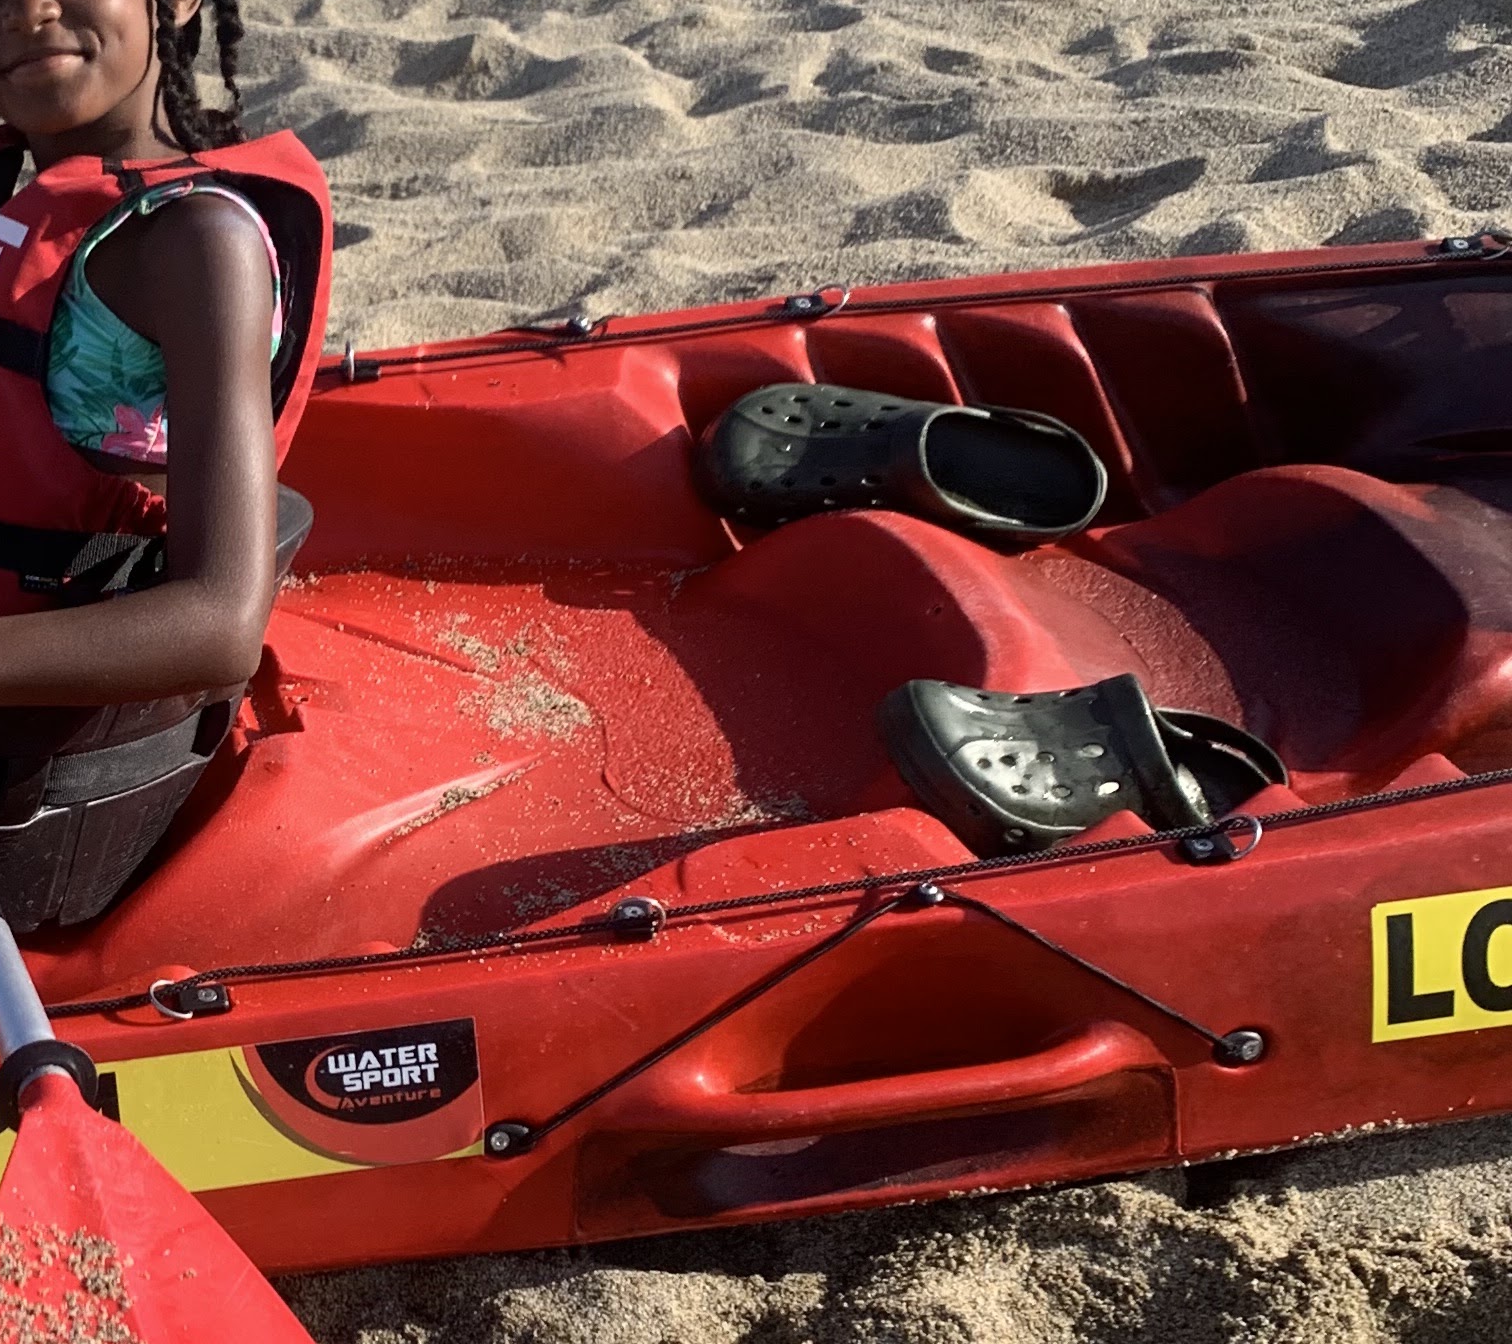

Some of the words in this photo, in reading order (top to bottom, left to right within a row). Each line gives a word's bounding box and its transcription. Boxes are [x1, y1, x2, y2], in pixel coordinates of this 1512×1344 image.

[327, 1042, 439, 1074] WATER
[342, 1062, 440, 1092] SPORT
[340, 1087, 442, 1110] Aventure
